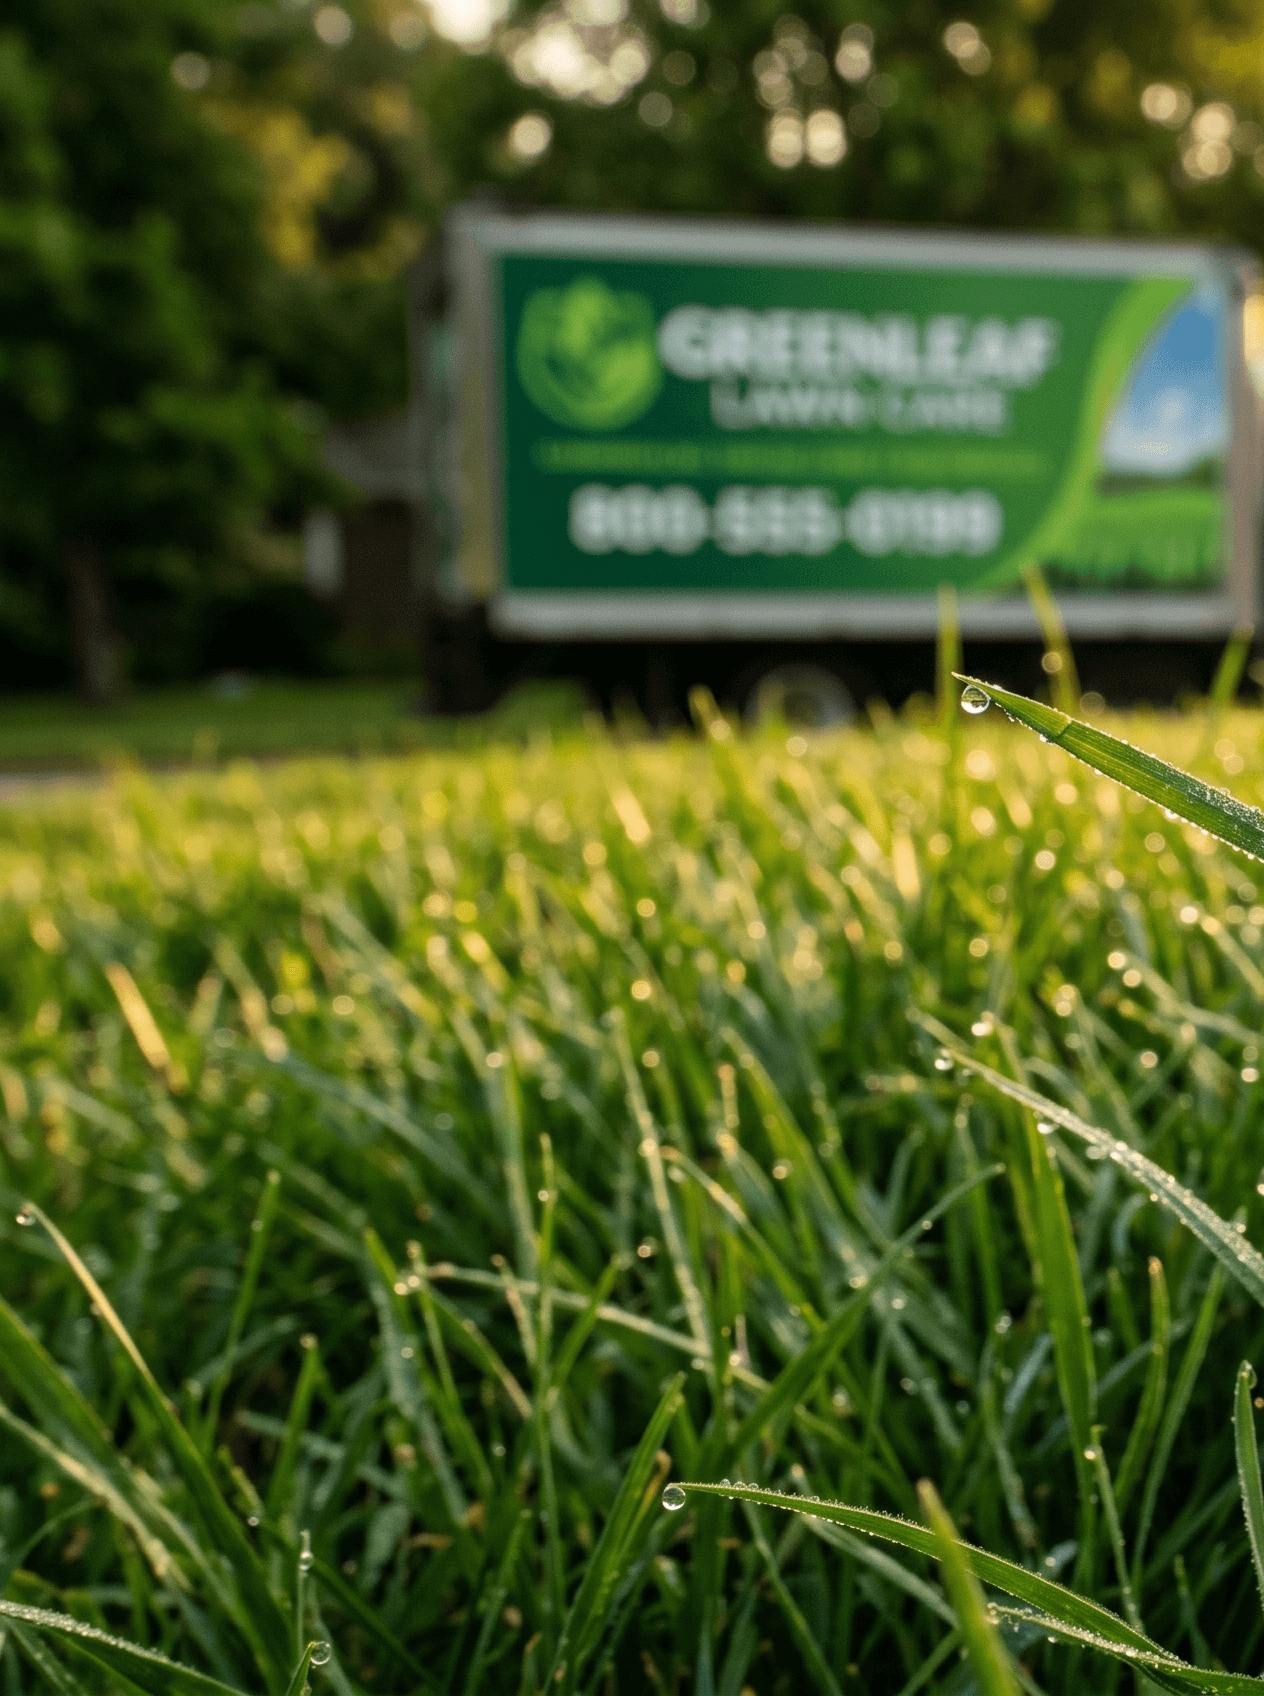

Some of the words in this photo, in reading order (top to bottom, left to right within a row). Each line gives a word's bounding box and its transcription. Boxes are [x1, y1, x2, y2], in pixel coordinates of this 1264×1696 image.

[660, 307, 1058, 385] GREENLEAF
[712, 379, 868, 429] LAWN
[876, 384, 1014, 433] CARE
